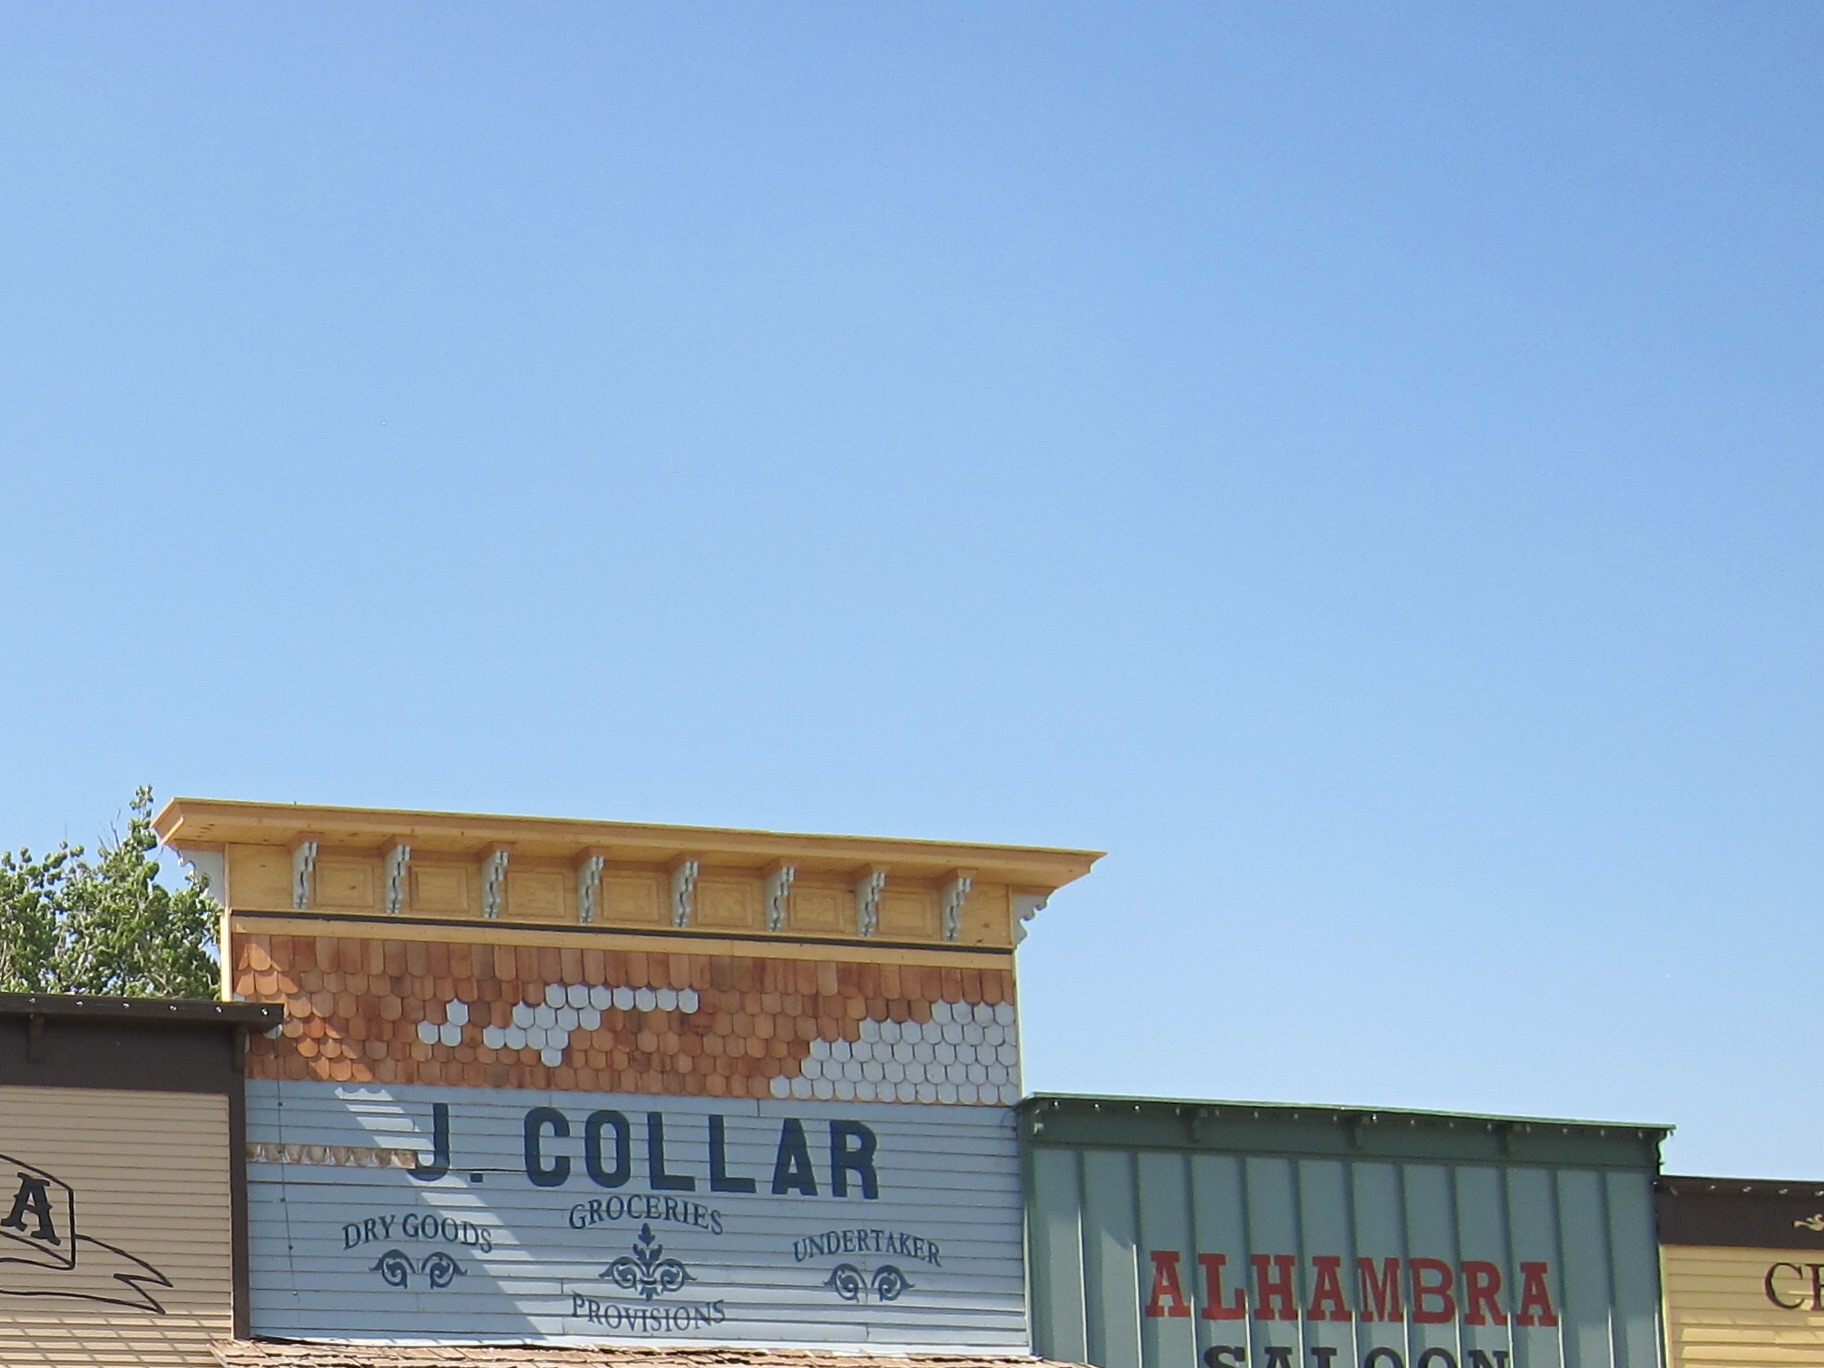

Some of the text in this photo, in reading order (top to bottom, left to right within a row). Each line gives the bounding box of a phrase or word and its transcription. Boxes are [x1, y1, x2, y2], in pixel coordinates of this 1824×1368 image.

[407, 1102, 879, 1200] J. COLLAR
[342, 1213, 494, 1253] DRY GOODS
[567, 1195, 724, 1236] GROCERIES
[792, 1228, 943, 1268] UNDERTAKER
[1143, 1250, 1559, 1327] ALHAMBRA
[571, 1291, 728, 1333] PROVISIONS
